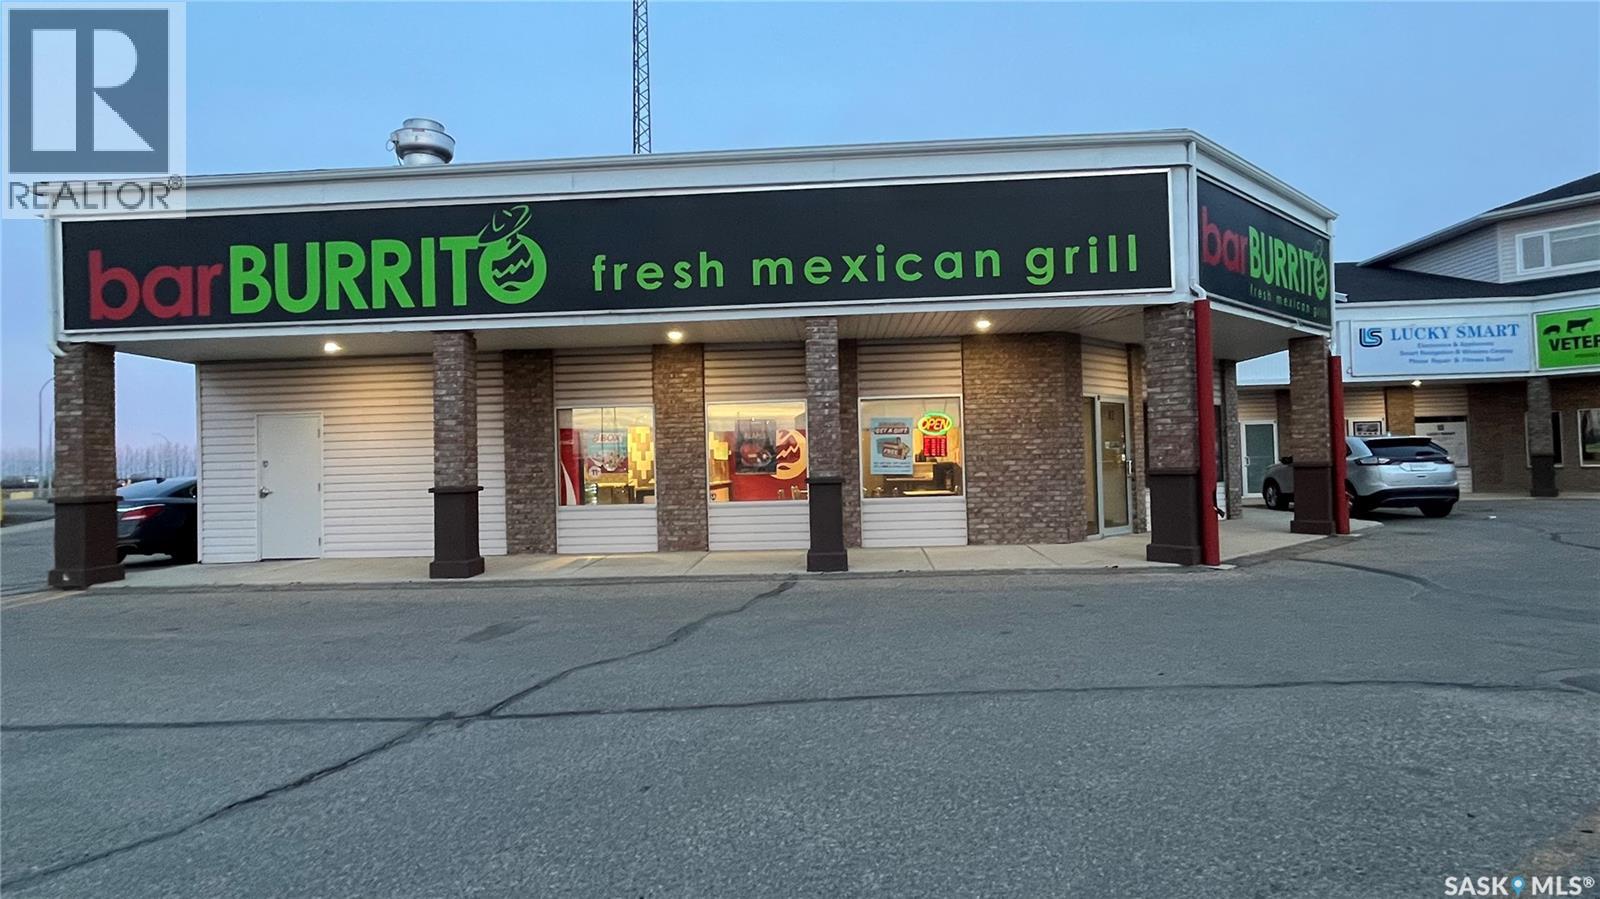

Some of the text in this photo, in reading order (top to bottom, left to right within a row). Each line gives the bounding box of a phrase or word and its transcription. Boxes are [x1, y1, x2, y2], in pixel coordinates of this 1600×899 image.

[592, 252, 725, 291] fresh
[752, 243, 1001, 286] mexican
[1025, 233, 1138, 286] grill
[1391, 324, 1520, 341] LUCKY SMART
[921, 418, 950, 431] OPEN
